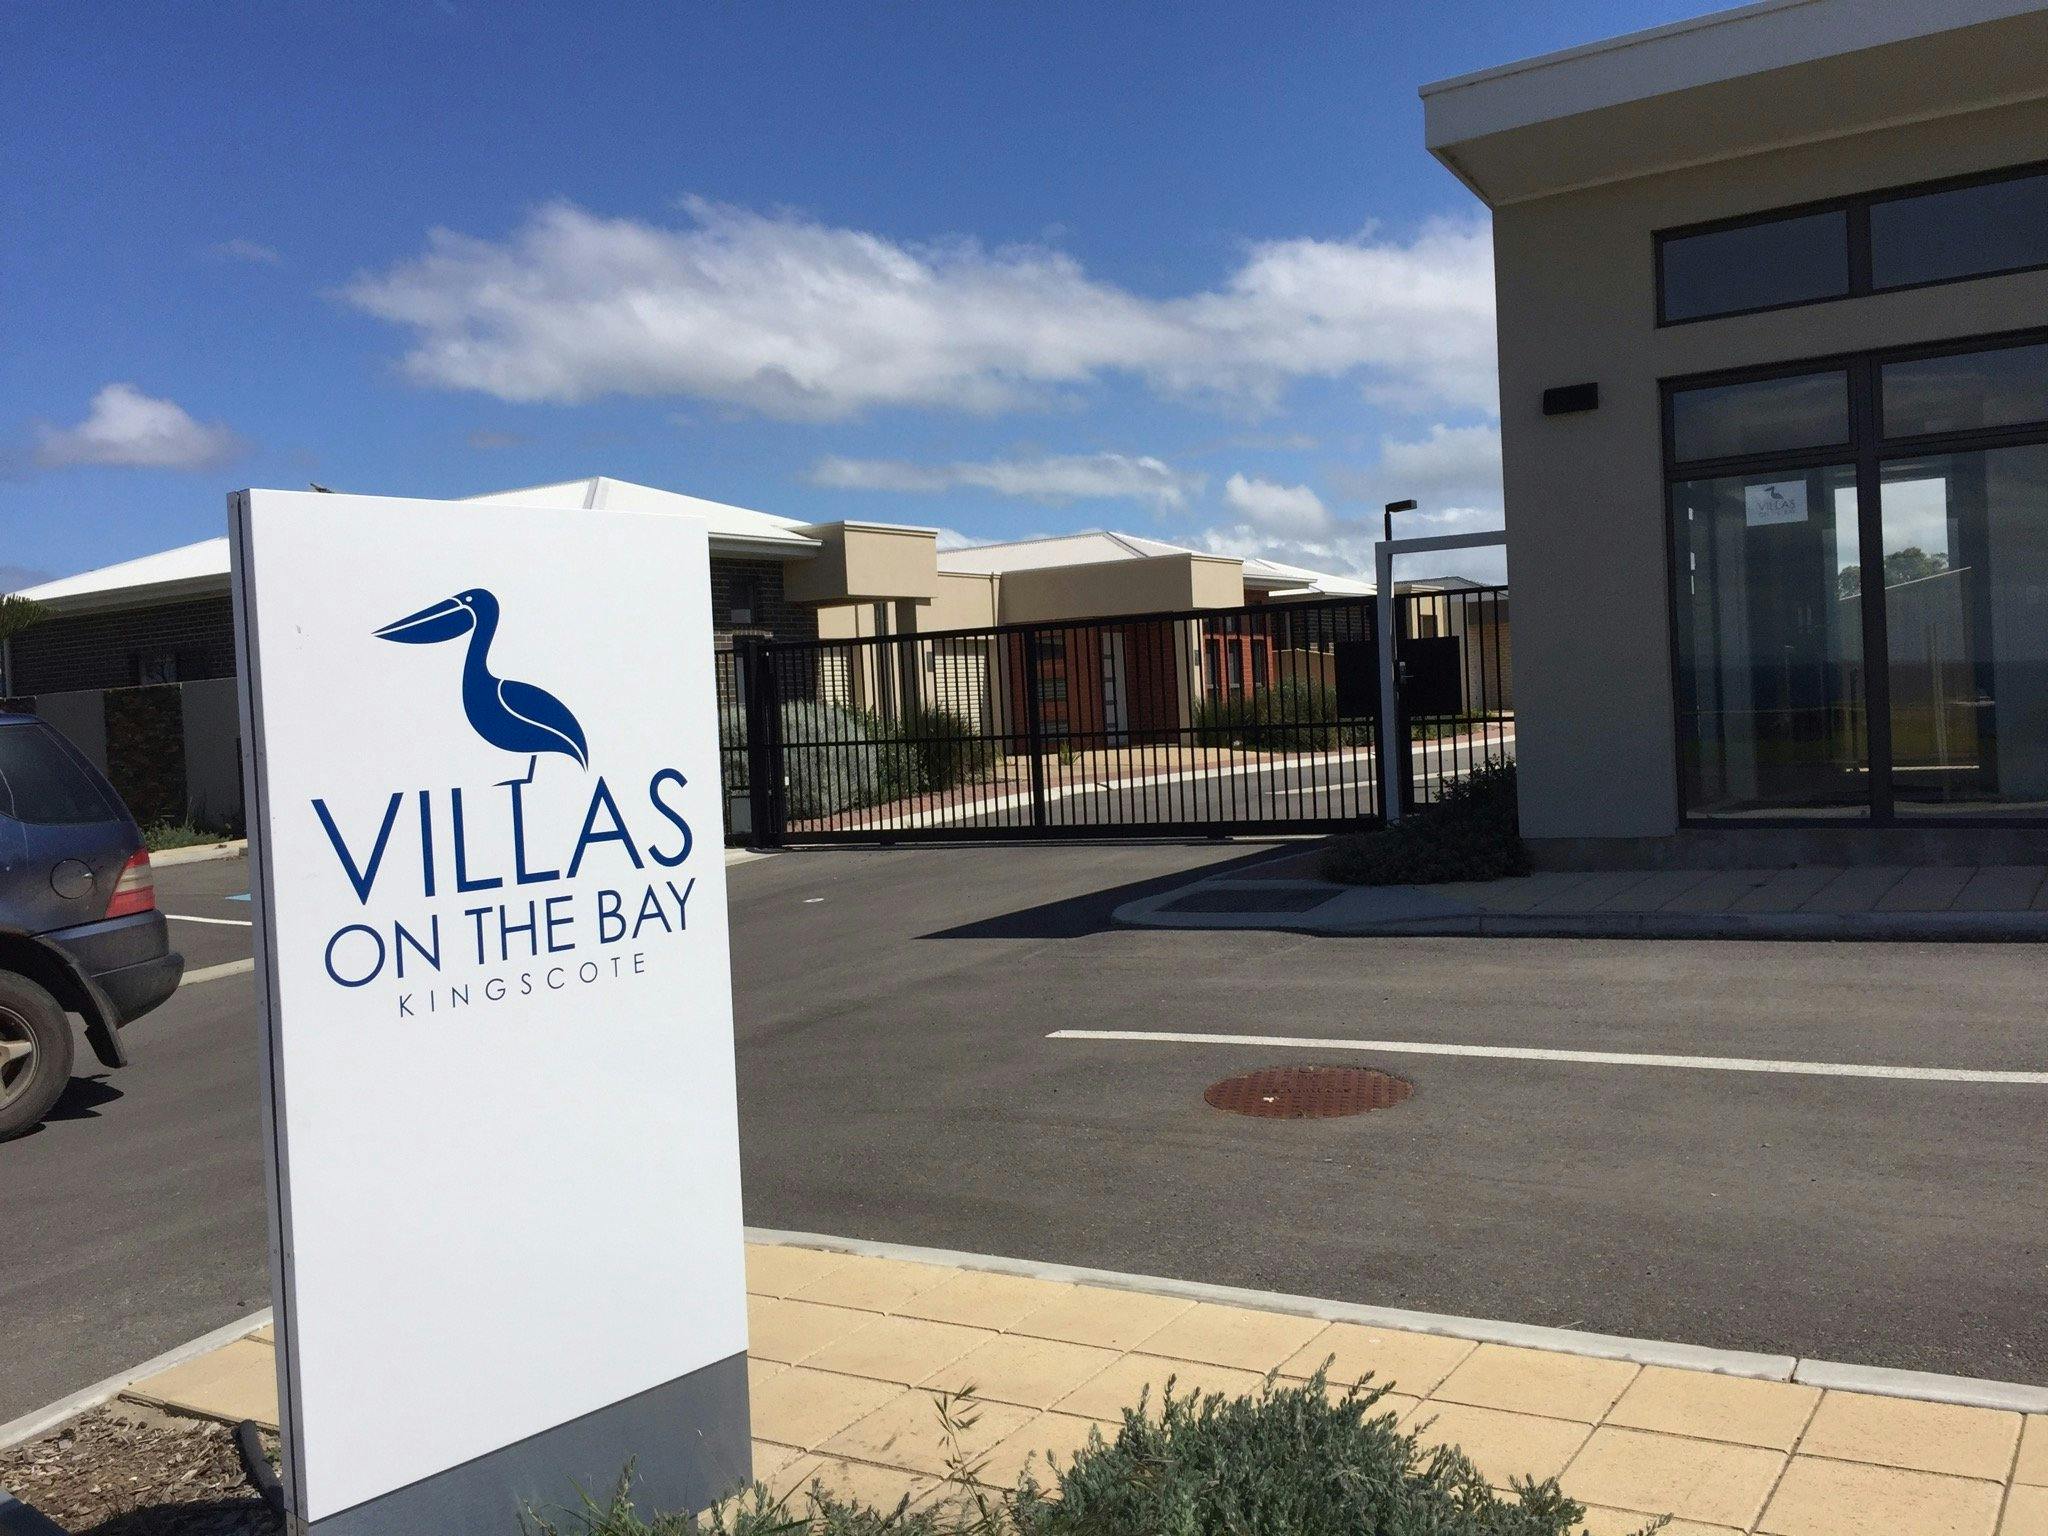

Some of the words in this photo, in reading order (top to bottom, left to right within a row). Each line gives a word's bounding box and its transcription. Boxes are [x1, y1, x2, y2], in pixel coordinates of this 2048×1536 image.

[310, 768, 693, 906] VILLAS
[324, 914, 441, 988] ON
[464, 894, 576, 965] THE
[597, 877, 696, 944] BAY
[399, 952, 646, 1018] KINGSCOTE
